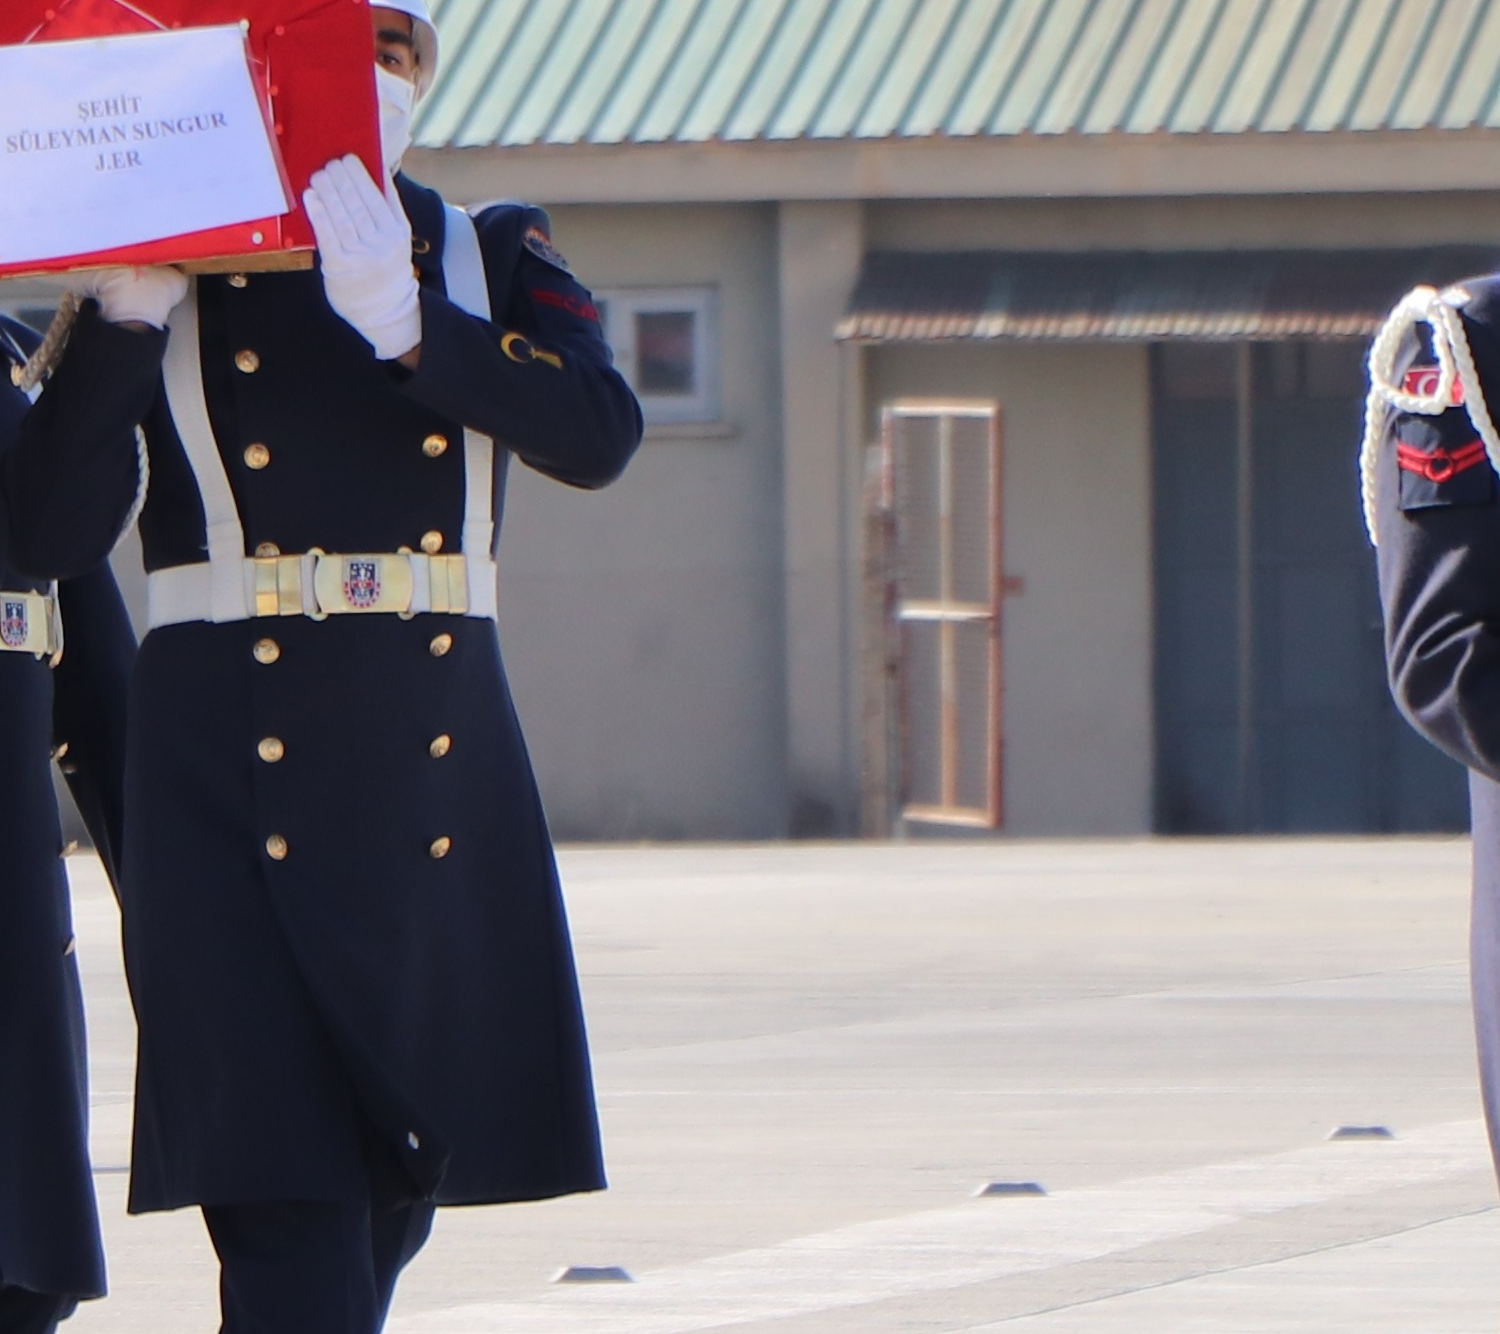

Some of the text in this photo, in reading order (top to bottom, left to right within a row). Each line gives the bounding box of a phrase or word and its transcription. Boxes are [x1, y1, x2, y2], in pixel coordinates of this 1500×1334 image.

[77, 94, 142, 121] ŞEHİT
[6, 112, 229, 154] SÜLEYMAN SUNGUR
[94, 150, 143, 172] J.ER
